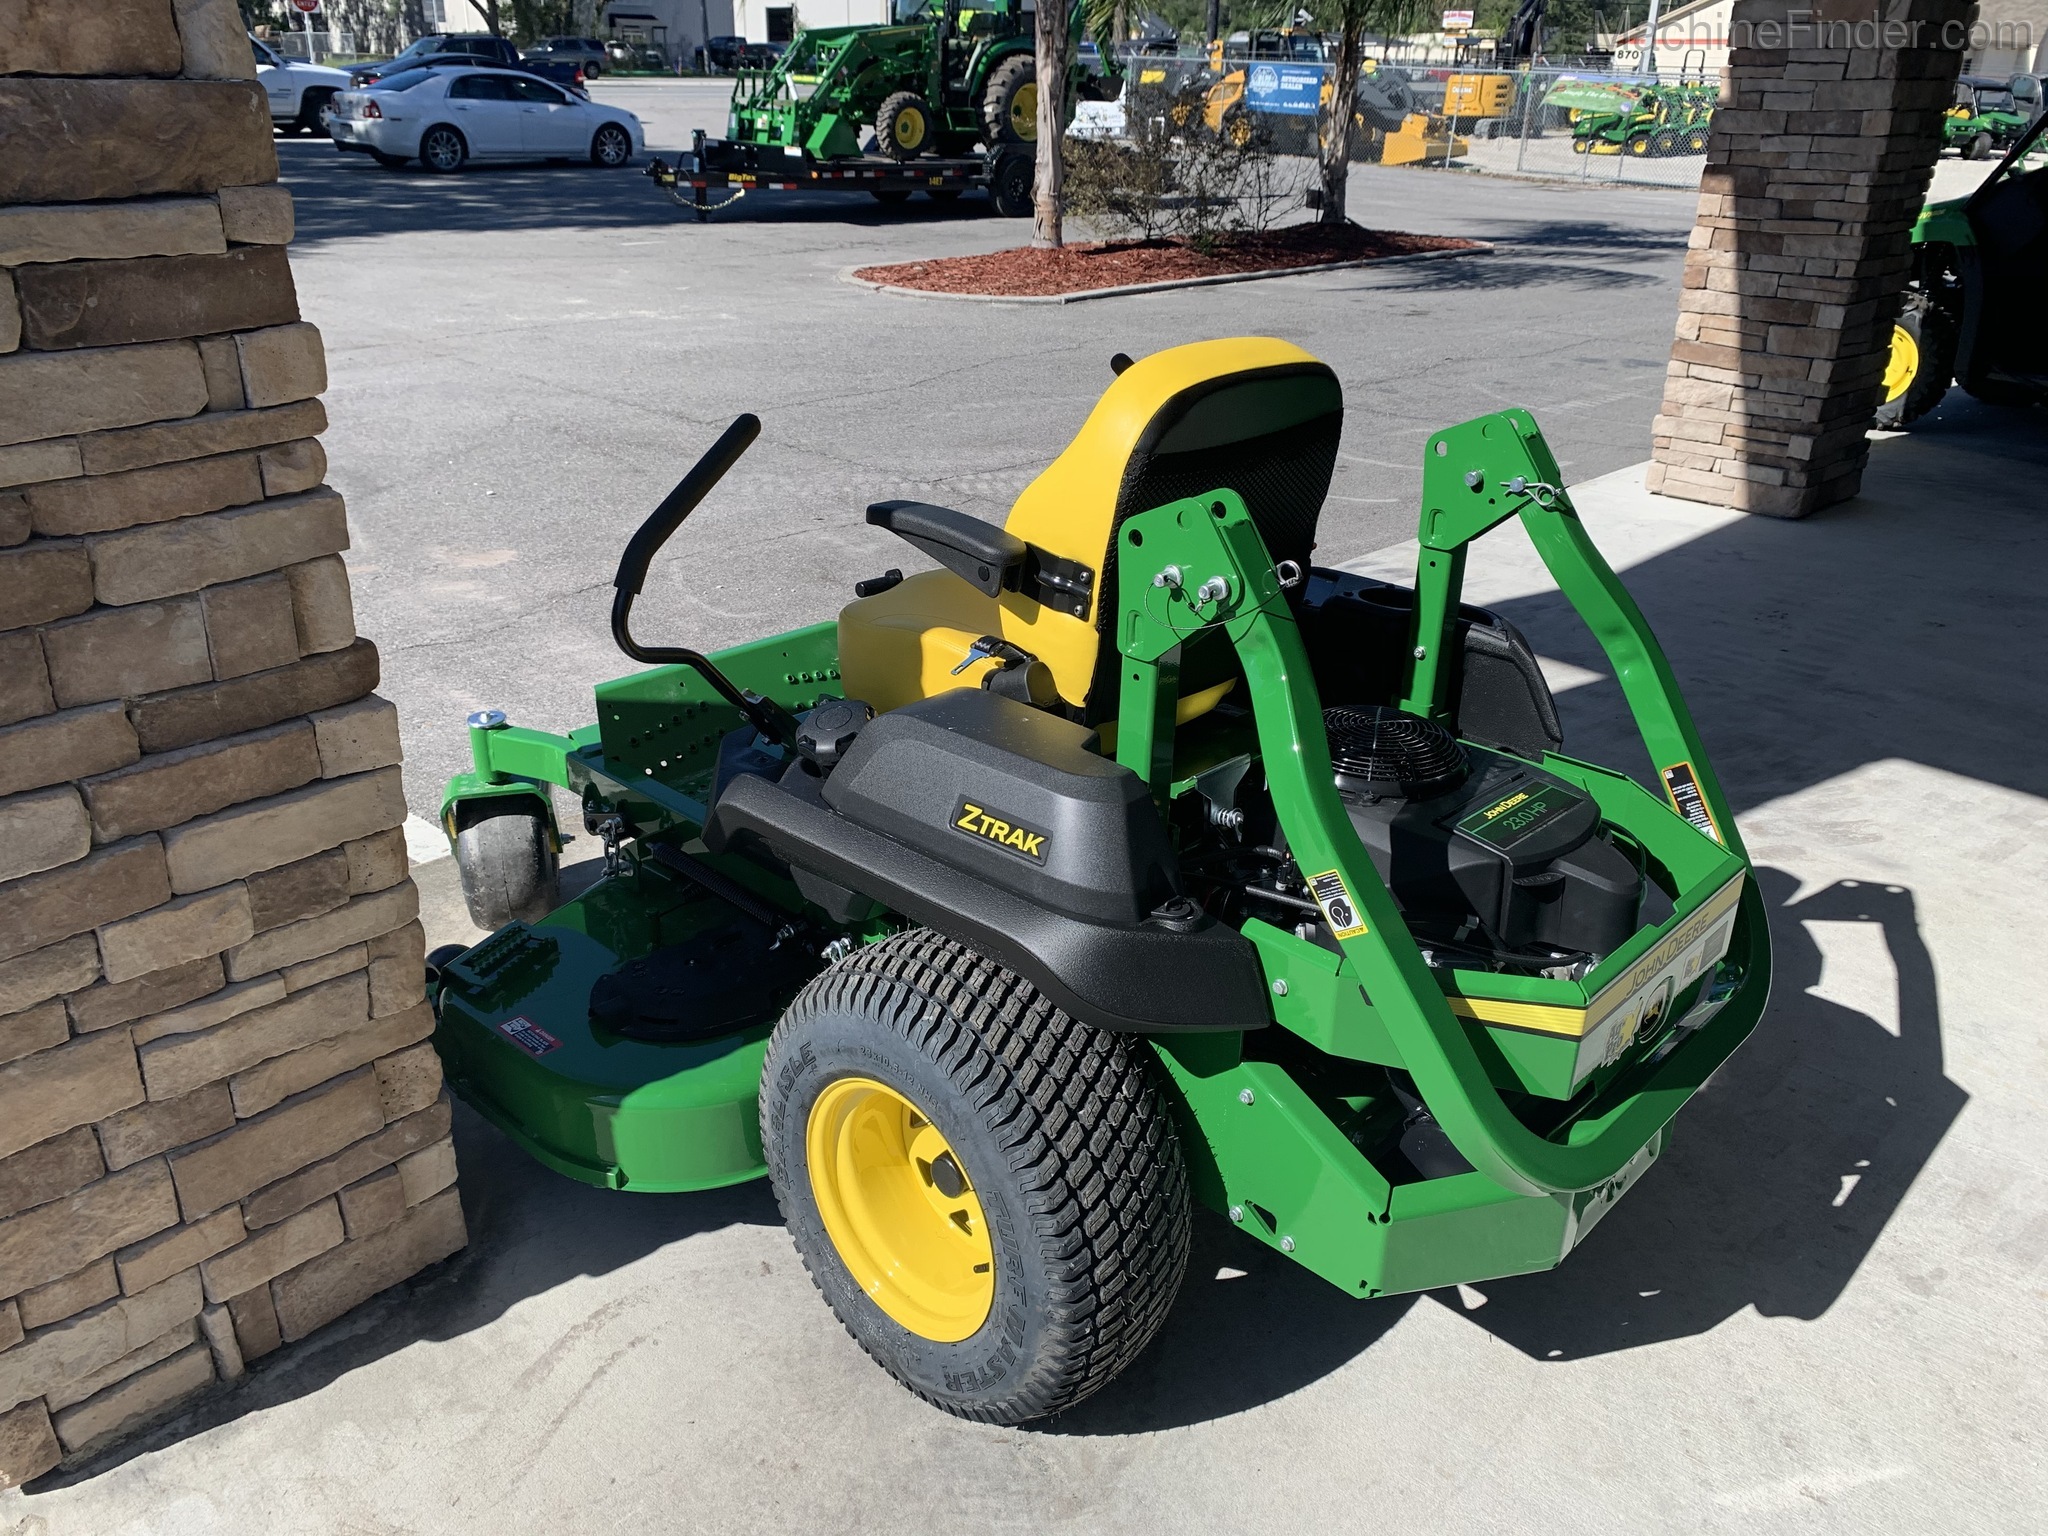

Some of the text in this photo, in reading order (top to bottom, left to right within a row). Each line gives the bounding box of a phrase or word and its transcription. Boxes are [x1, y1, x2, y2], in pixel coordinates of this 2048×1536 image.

[1617, 50, 1644, 60] 870
[1483, 792, 1529, 820] JOHN DEERE
[1502, 801, 1548, 830] 23.0 HP
[957, 803, 1045, 857] ZTRAK
[1626, 950, 1666, 996] JOHN
[1666, 912, 1710, 959] DEERE
